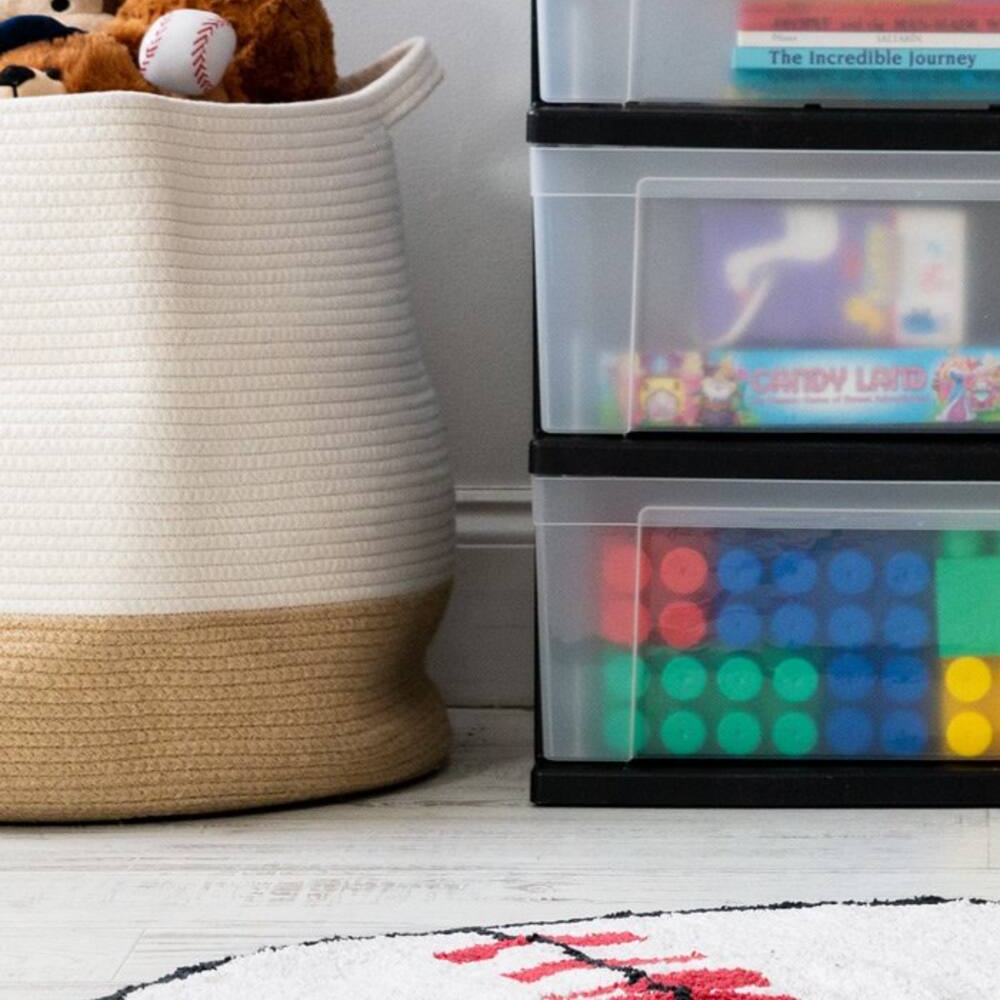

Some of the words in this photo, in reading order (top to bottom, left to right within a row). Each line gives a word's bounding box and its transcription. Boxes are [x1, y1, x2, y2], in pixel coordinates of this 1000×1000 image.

[768, 49, 802, 65] The
[809, 48, 903, 65] Incredible
[908, 50, 977, 69] Journey
[750, 365, 848, 393] CANDY
[855, 364, 928, 393] LAND
